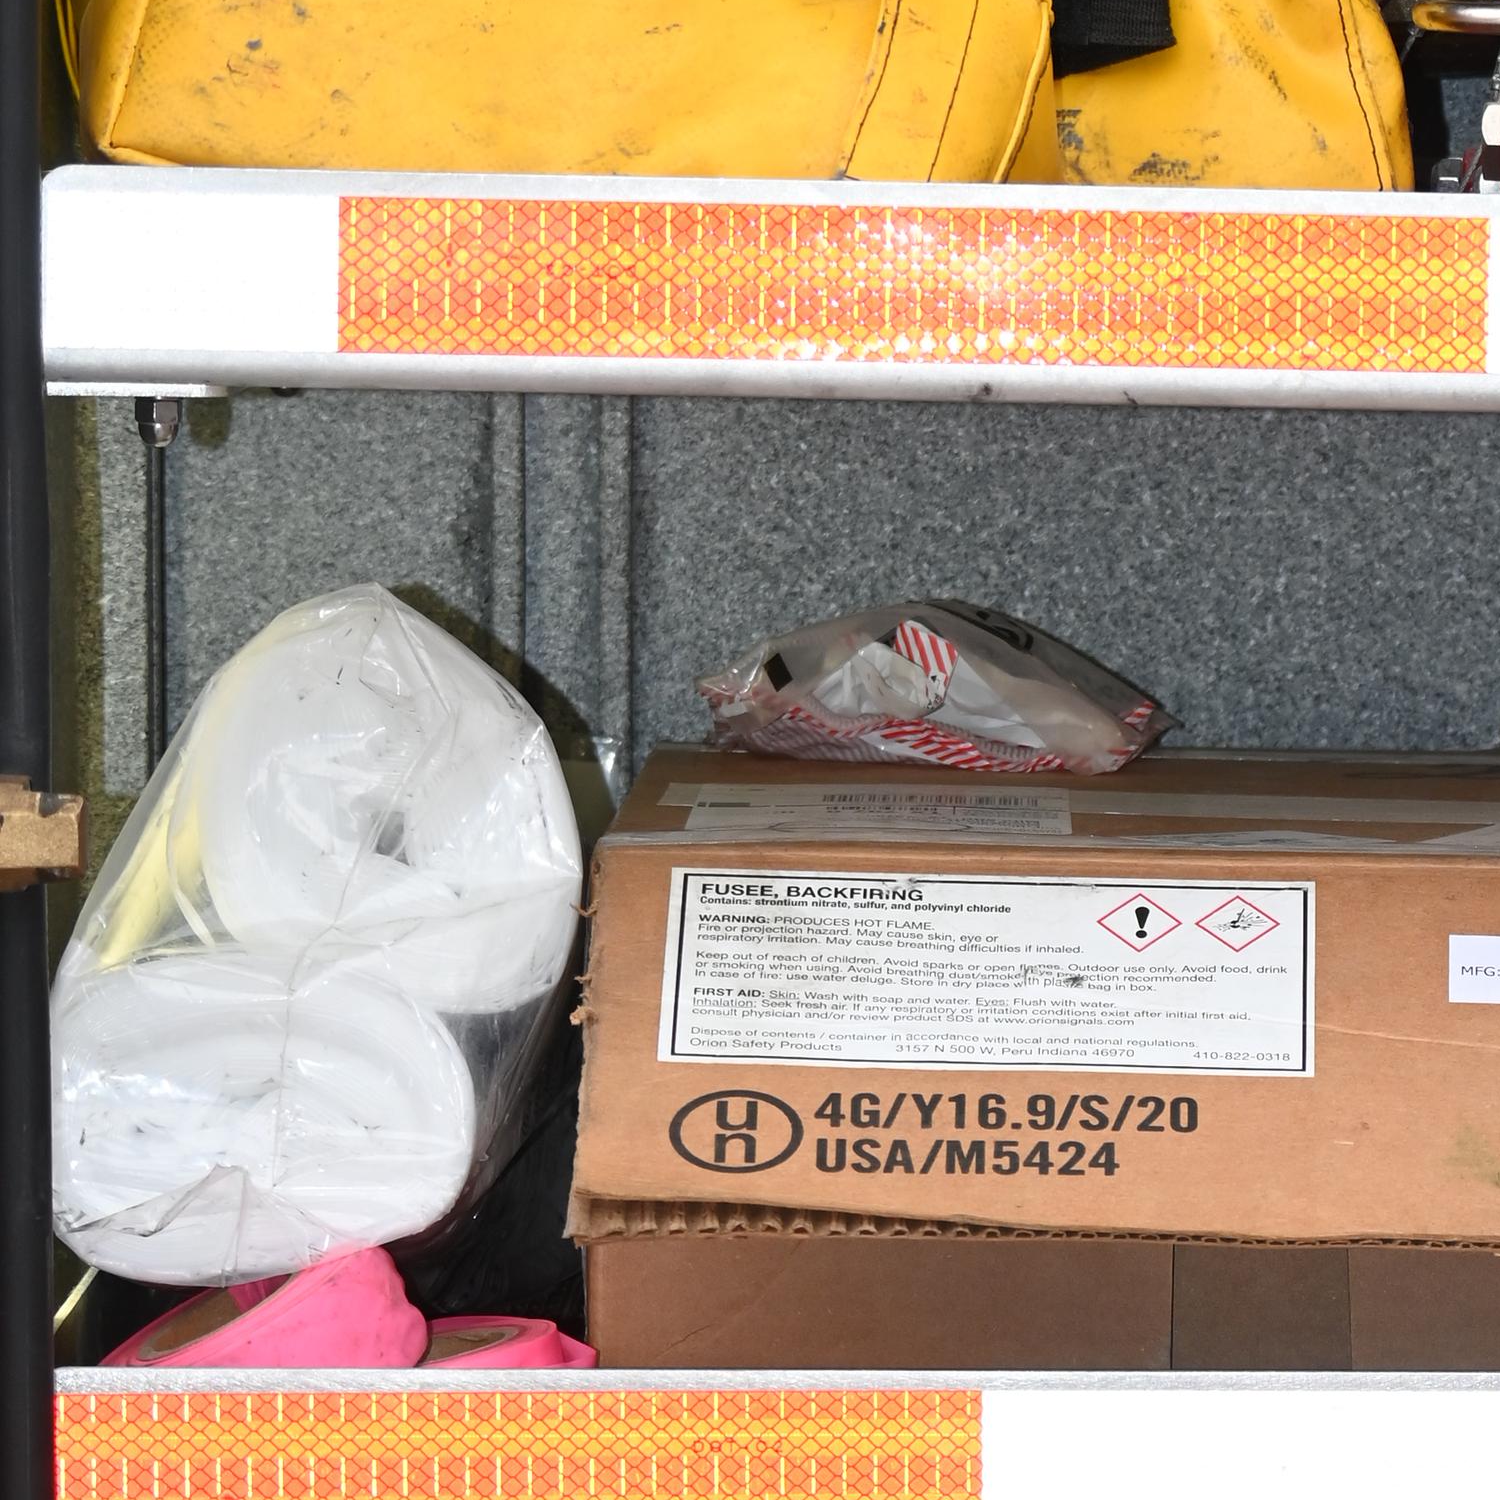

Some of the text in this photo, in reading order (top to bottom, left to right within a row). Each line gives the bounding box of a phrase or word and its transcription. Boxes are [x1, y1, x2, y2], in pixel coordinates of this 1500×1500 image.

[701, 884, 923, 901] FUSEE, BACKFIRING
[700, 896, 751, 905] Contains:
[755, 898, 808, 907] strontium
[812, 900, 850, 909] nitrate,
[854, 901, 887, 910] sulfur,
[915, 903, 963, 913] polyvinyl
[967, 905, 1011, 913] chloride
[699, 914, 935, 930] WARNING: PRODUCES HOT FLAME.
[699, 924, 721, 932] Fire
[742, 925, 802, 936] projection
[807, 928, 852, 936] hazard.
[857, 929, 882, 938] May
[887, 931, 923, 940] cause
[928, 933, 956, 942] skin,
[960, 935, 981, 944] eye
[986, 935, 999, 943] or
[697, 933, 1084, 954] respiratory irritation. May cause breathing difficulties if inhaled.
[694, 988, 733, 997] FIRST
[737, 989, 765, 998] AID:
[769, 990, 800, 999] Skin:
[805, 991, 838, 1001] Wash
[843, 993, 868, 1002] with
[873, 996, 903, 1004] soap
[907, 997, 930, 1005] and
[976, 997, 1009, 1007] Eyes:
[1014, 998, 1047, 1007] Flush
[1051, 1000, 1076, 1008] with
[1081, 1001, 1117, 1009] water.
[690, 1037, 842, 1051] Orion Safety Products
[896, 1044, 929, 1053] 3157
[935, 1045, 945, 1053] N
[951, 1045, 975, 1054] 500
[1002, 1047, 1032, 1056] Peru
[1038, 1048, 1087, 1057] Indiana
[1092, 1049, 1135, 1058] 46970
[1193, 1051, 1290, 1061] 410-822-0318
[814, 1092, 1199, 1134] 4G/Y16.9/S/20
[816, 1138, 1120, 1176] USA/M5424
